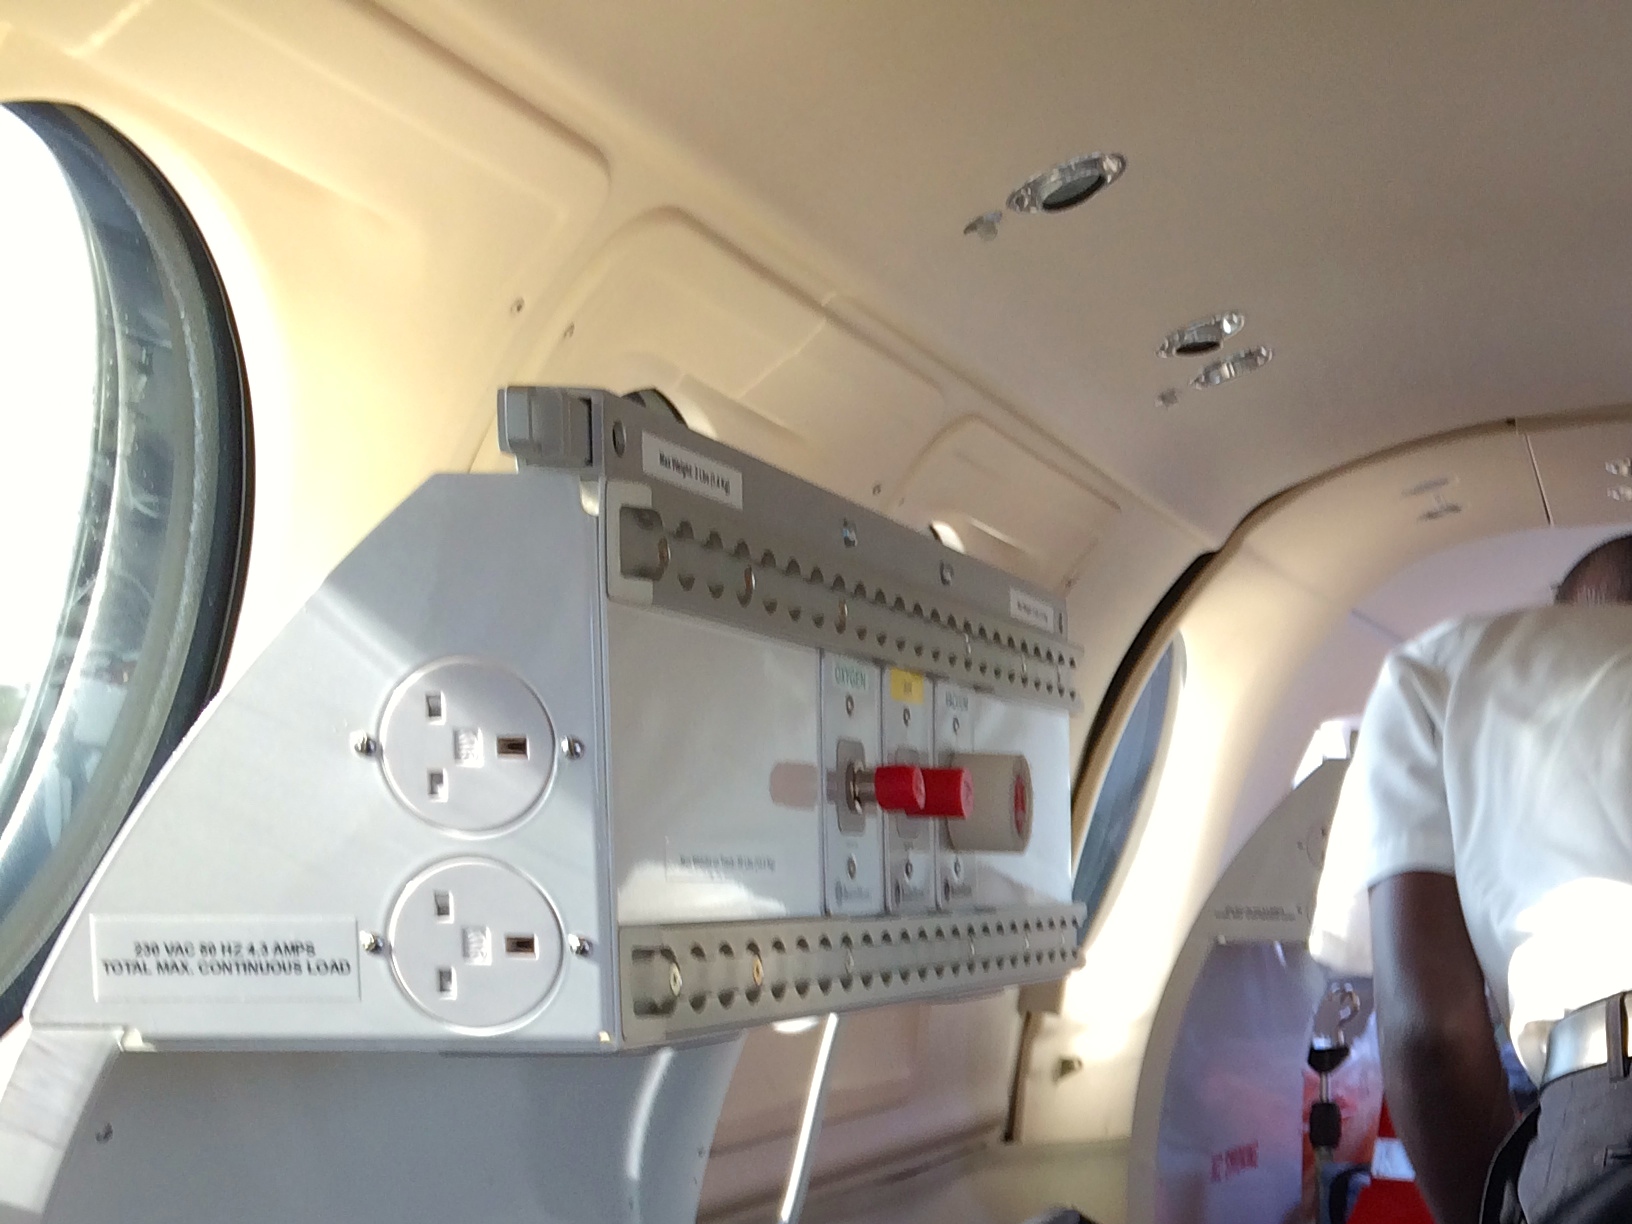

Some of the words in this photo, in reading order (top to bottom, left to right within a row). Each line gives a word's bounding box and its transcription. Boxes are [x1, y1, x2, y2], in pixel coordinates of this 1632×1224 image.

[834, 665, 867, 690] OXYGEN
[163, 940, 195, 958] VAC
[272, 940, 317, 958] AMPS
[101, 958, 152, 977] TOTAL
[156, 958, 194, 977] MAX.
[199, 958, 303, 977] CONTINUOUS
[306, 958, 352, 977] LOAD
